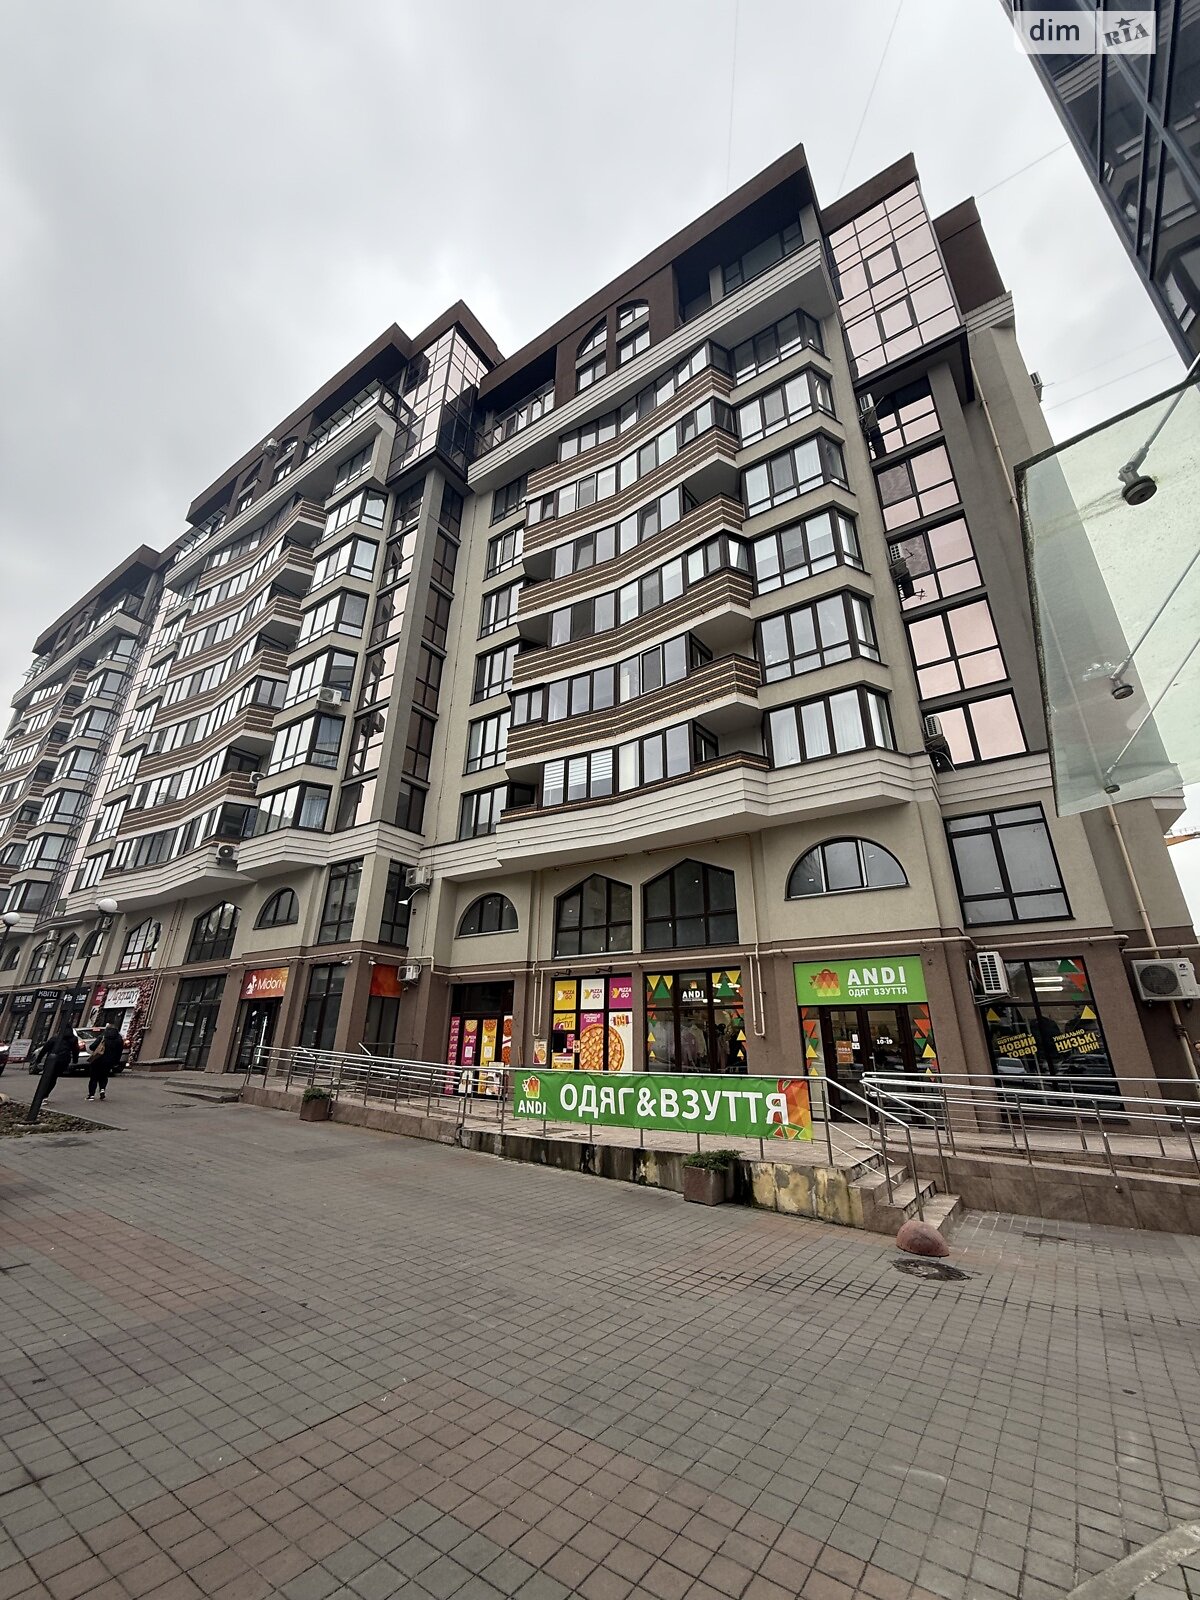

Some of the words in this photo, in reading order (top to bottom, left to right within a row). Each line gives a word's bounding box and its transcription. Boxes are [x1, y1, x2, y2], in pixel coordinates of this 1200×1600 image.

[257, 977, 282, 990] Midori
[848, 966, 906, 985] ANDI
[682, 990, 704, 998] ANDI
[848, 988, 870, 997] ОДЯГ
[874, 987, 908, 996] ВЗУТТЯ
[999, 1033, 1037, 1054] НОВИЙ
[1055, 1032, 1097, 1052] НИЗЬКІ
[1078, 1041, 1100, 1054] ЦІНИ
[517, 1100, 547, 1116] ANDI
[559, 1083, 789, 1125] ОДЯГ&ВЗУТТЯ
